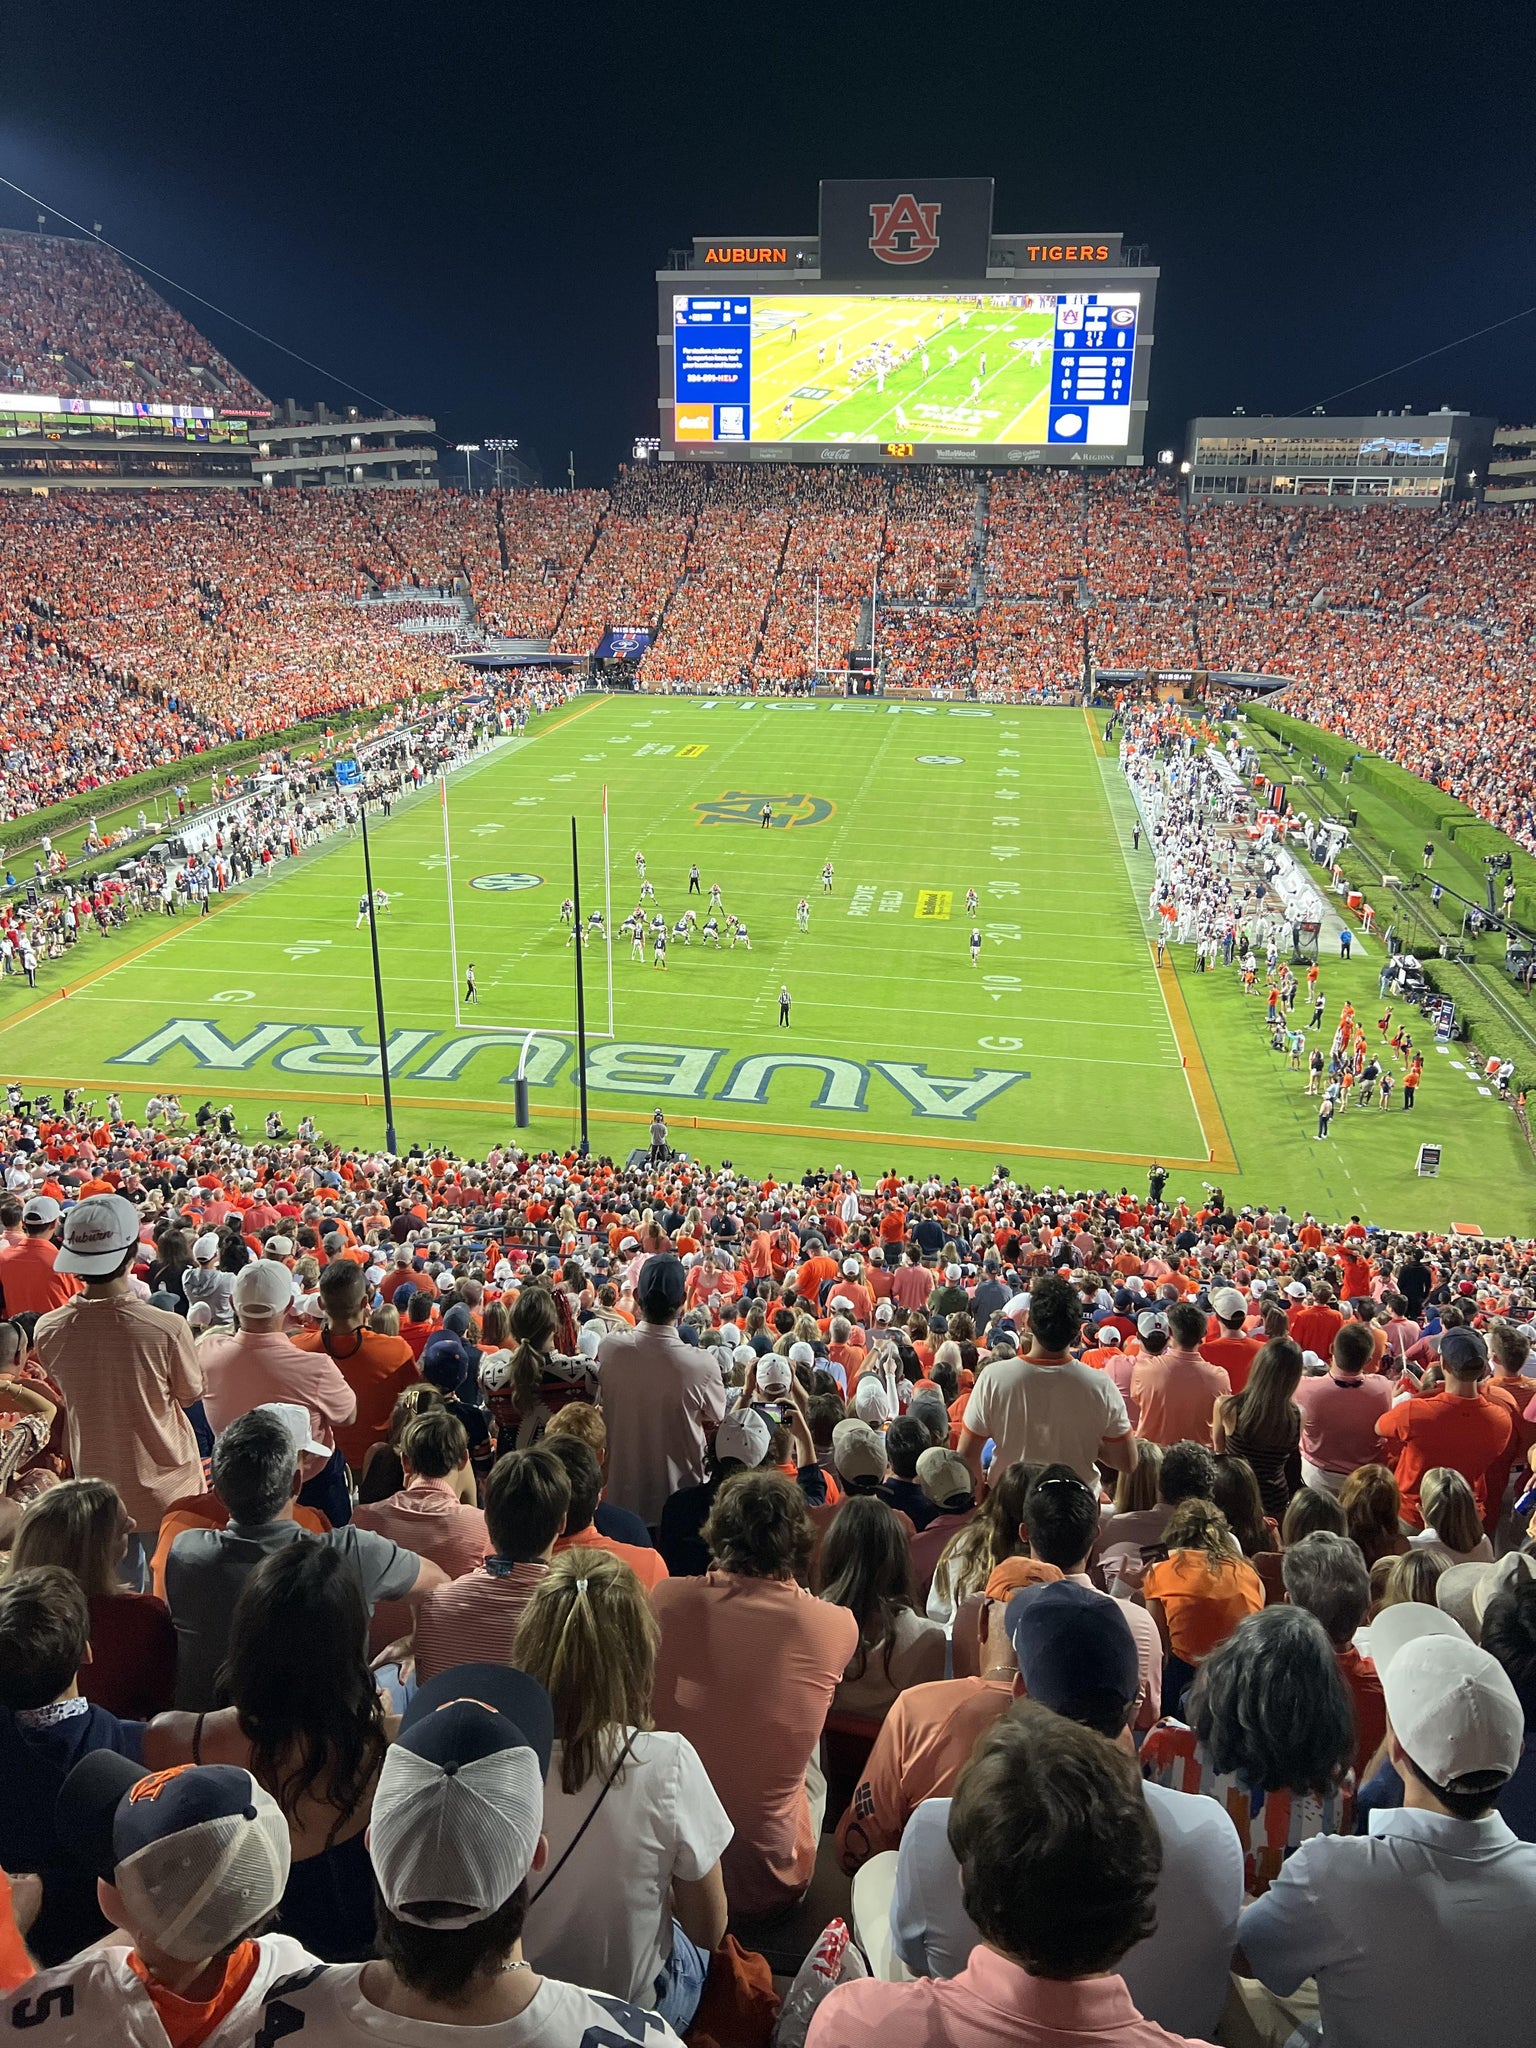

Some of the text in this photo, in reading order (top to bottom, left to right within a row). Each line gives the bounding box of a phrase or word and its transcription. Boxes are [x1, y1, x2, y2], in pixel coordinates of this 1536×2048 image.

[868, 194, 942, 265] AU
[705, 248, 787, 264] AUBURN
[1027, 246, 1109, 260] TIGERS
[888, 444, 913, 456] 9:27
[689, 700, 996, 717] TIGERS
[987, 880, 1021, 895] 30
[847, 884, 878, 916] PAT DYE
[878, 890, 904, 913] FIELD
[985, 923, 1022, 940] 20
[282, 940, 332, 954] 10
[982, 975, 1023, 992] 10
[208, 990, 256, 1002] G
[977, 1036, 1024, 1050] G
[105, 1018, 1031, 1121] AUBURN
[67, 1228, 113, 1244] Auburn
[12, 1985, 75, 2029] 5
